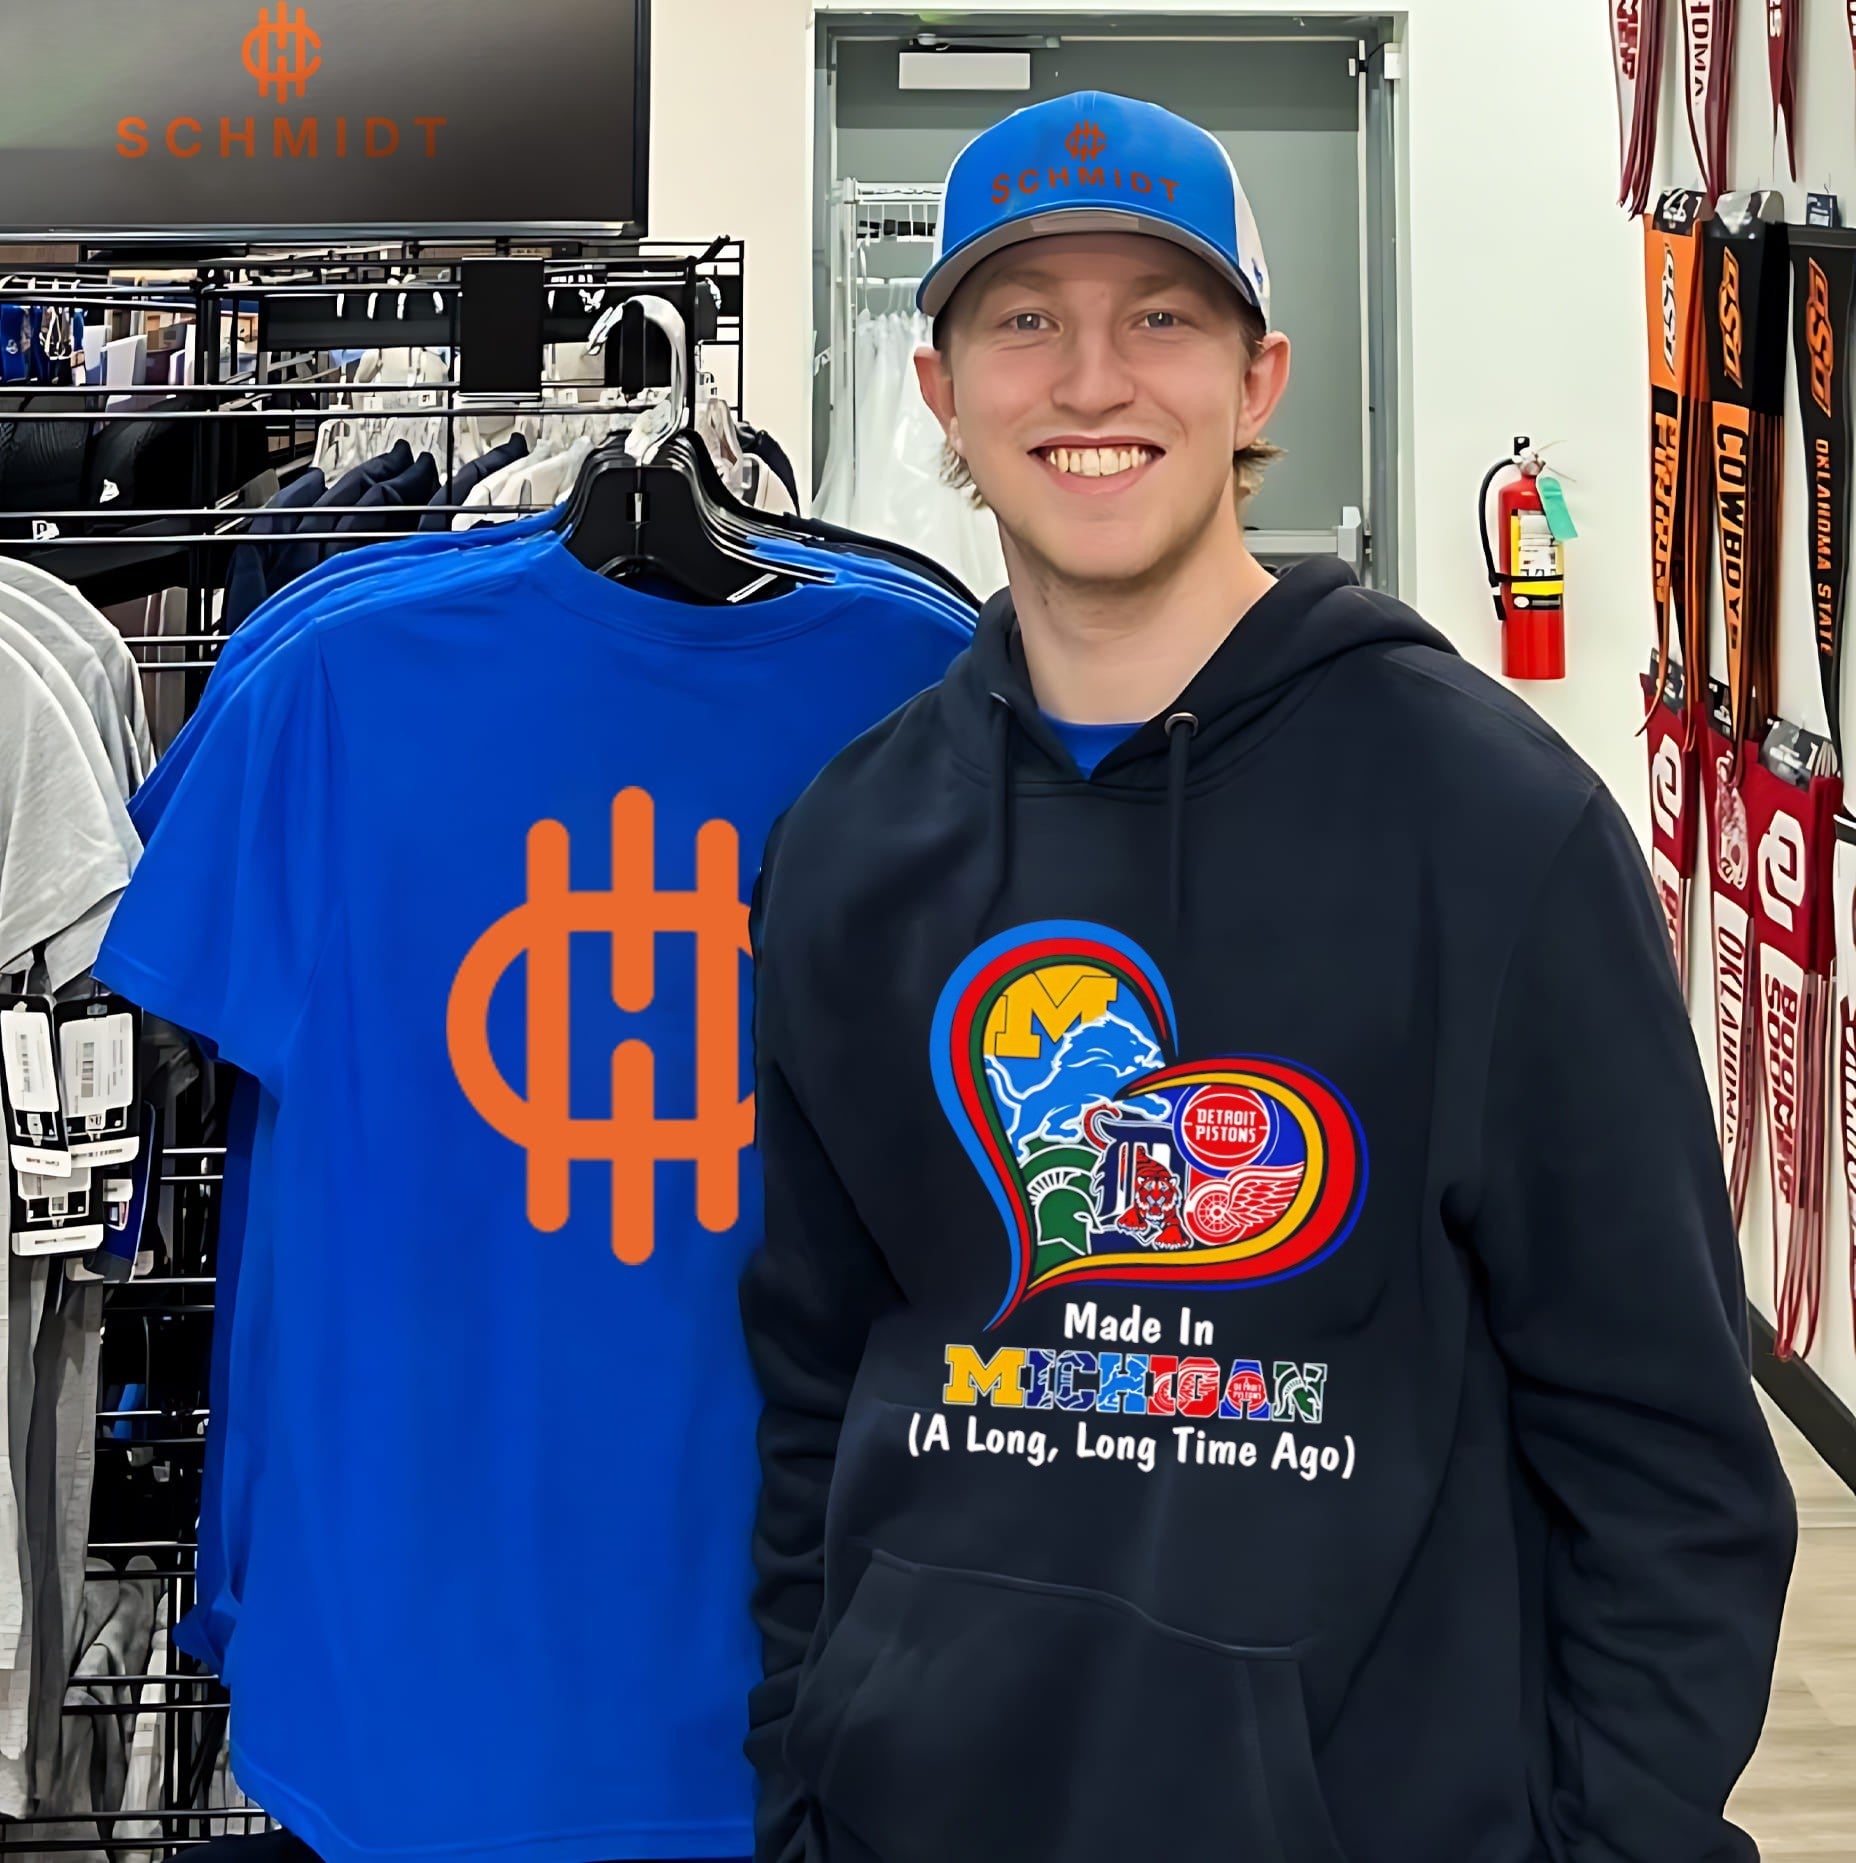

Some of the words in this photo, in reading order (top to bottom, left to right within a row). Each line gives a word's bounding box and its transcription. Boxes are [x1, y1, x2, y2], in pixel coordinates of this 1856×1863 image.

[115, 117, 447, 158] SCHMIDT
[991, 167, 1179, 204] SCHMIDT
[1815, 438, 1832, 570] OKLAHOMA
[1195, 1125, 1257, 1143] PISTONS
[1196, 1108, 1257, 1126] DETROIT
[1063, 1301, 1161, 1344] Made
[1179, 1307, 1214, 1346] In
[942, 1344, 1327, 1423] MICHIGAN
[907, 1412, 950, 1457] (A
[967, 1415, 1059, 1467] Long,
[1076, 1421, 1156, 1472] Long
[1172, 1426, 1257, 1465] Time
[1270, 1432, 1355, 1481] Ago)
